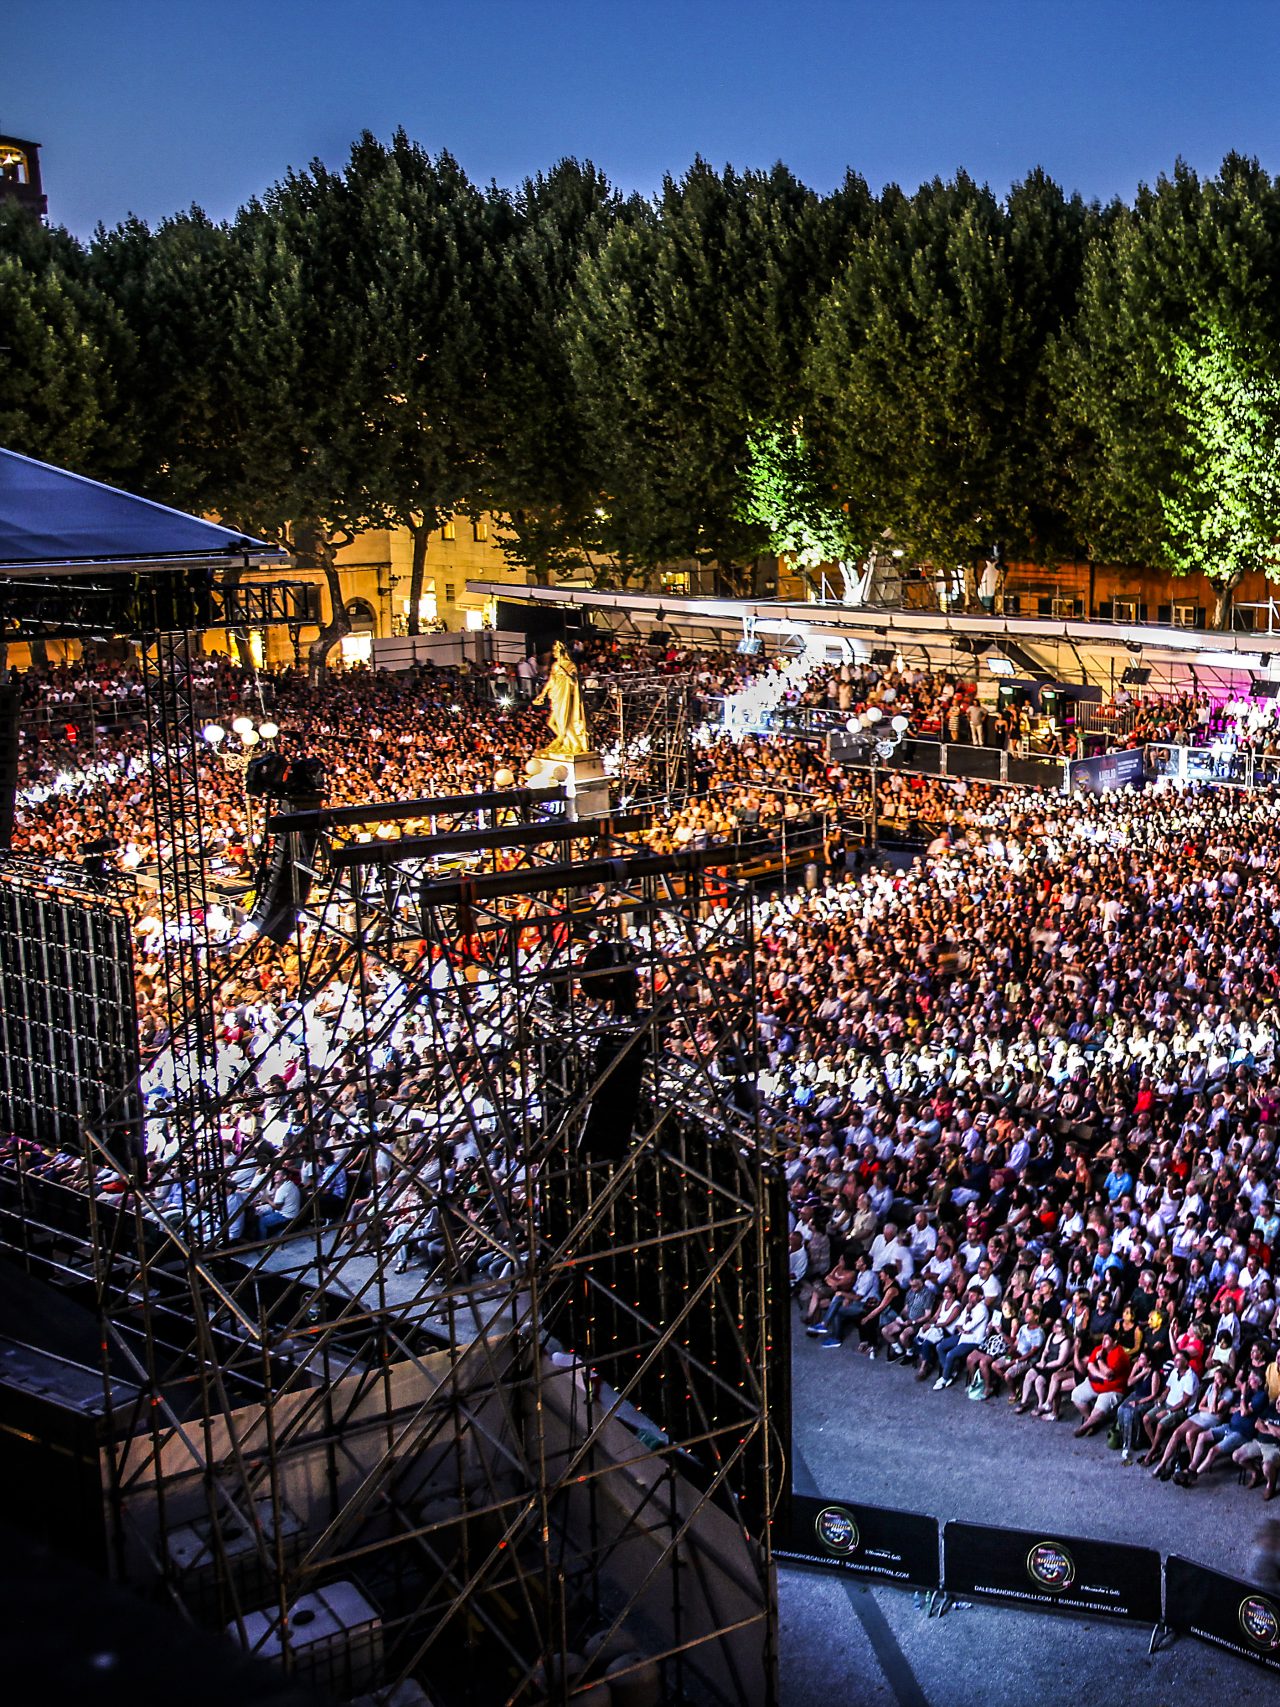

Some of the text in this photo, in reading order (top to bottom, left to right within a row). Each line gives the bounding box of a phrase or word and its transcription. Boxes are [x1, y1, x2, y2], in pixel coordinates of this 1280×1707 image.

[974, 1585, 1129, 1614] DALESSANDROEGALLI.COM SUMMER-FESTIVAL.COM
[1190, 1625, 1260, 1660] DALESSANDROEGALLI.COM
